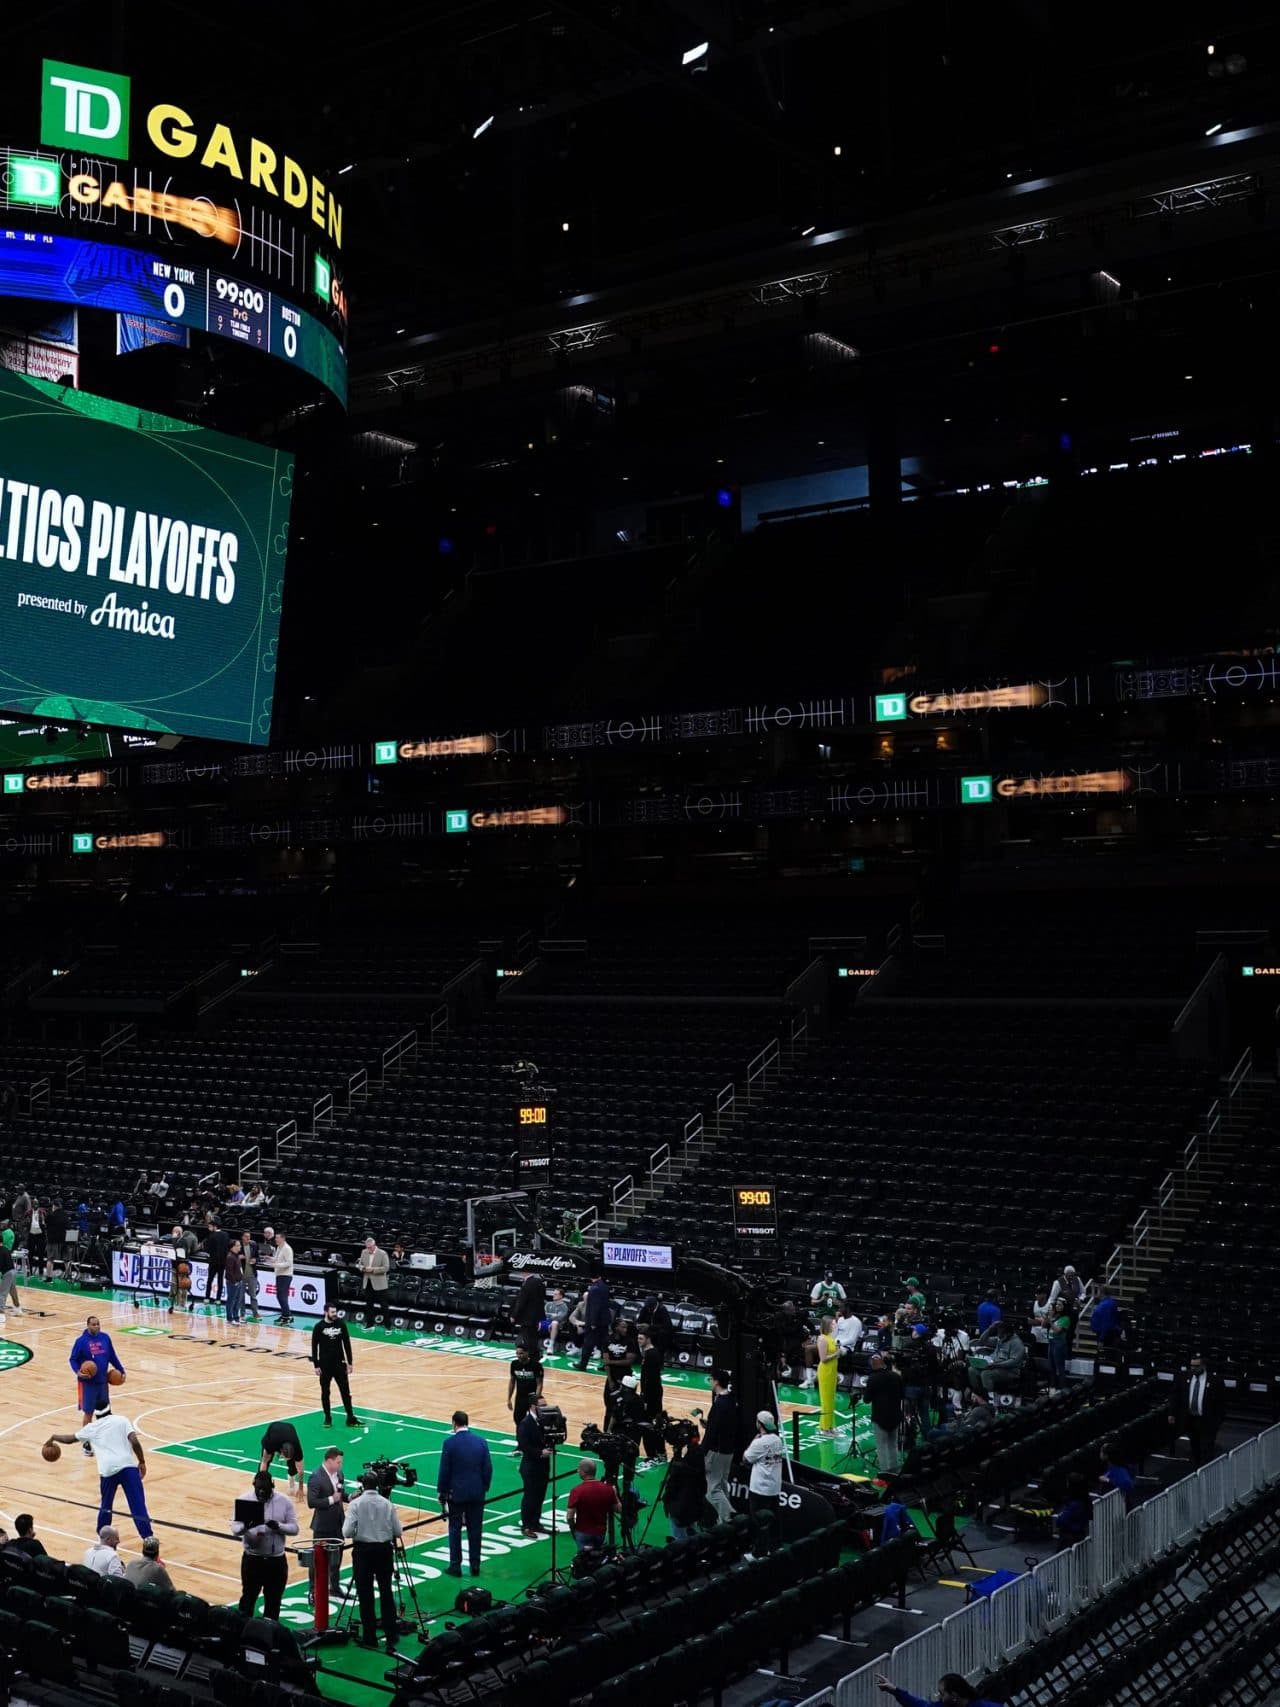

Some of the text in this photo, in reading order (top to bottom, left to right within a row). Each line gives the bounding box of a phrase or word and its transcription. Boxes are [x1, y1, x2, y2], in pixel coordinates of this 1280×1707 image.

[51, 77, 342, 249] TD GARDEN
[153, 261, 195, 285] NEW YORK
[163, 283, 185, 318] 0
[216, 278, 263, 314] 99:00
[284, 325, 297, 358] 0
[33, 351, 72, 369] UNIVERSITY
[87, 500, 238, 605] PLAYOFFS
[18, 592, 176, 640] presented by Amica
[520, 1108, 546, 1124] 99:00
[529, 1159, 549, 1167] TISSOT
[740, 1192, 770, 1204] 99:00
[508, 1252, 550, 1269] Different
[615, 1247, 647, 1263] PLAYOFFS
[301, 1291, 319, 1302] TNT
